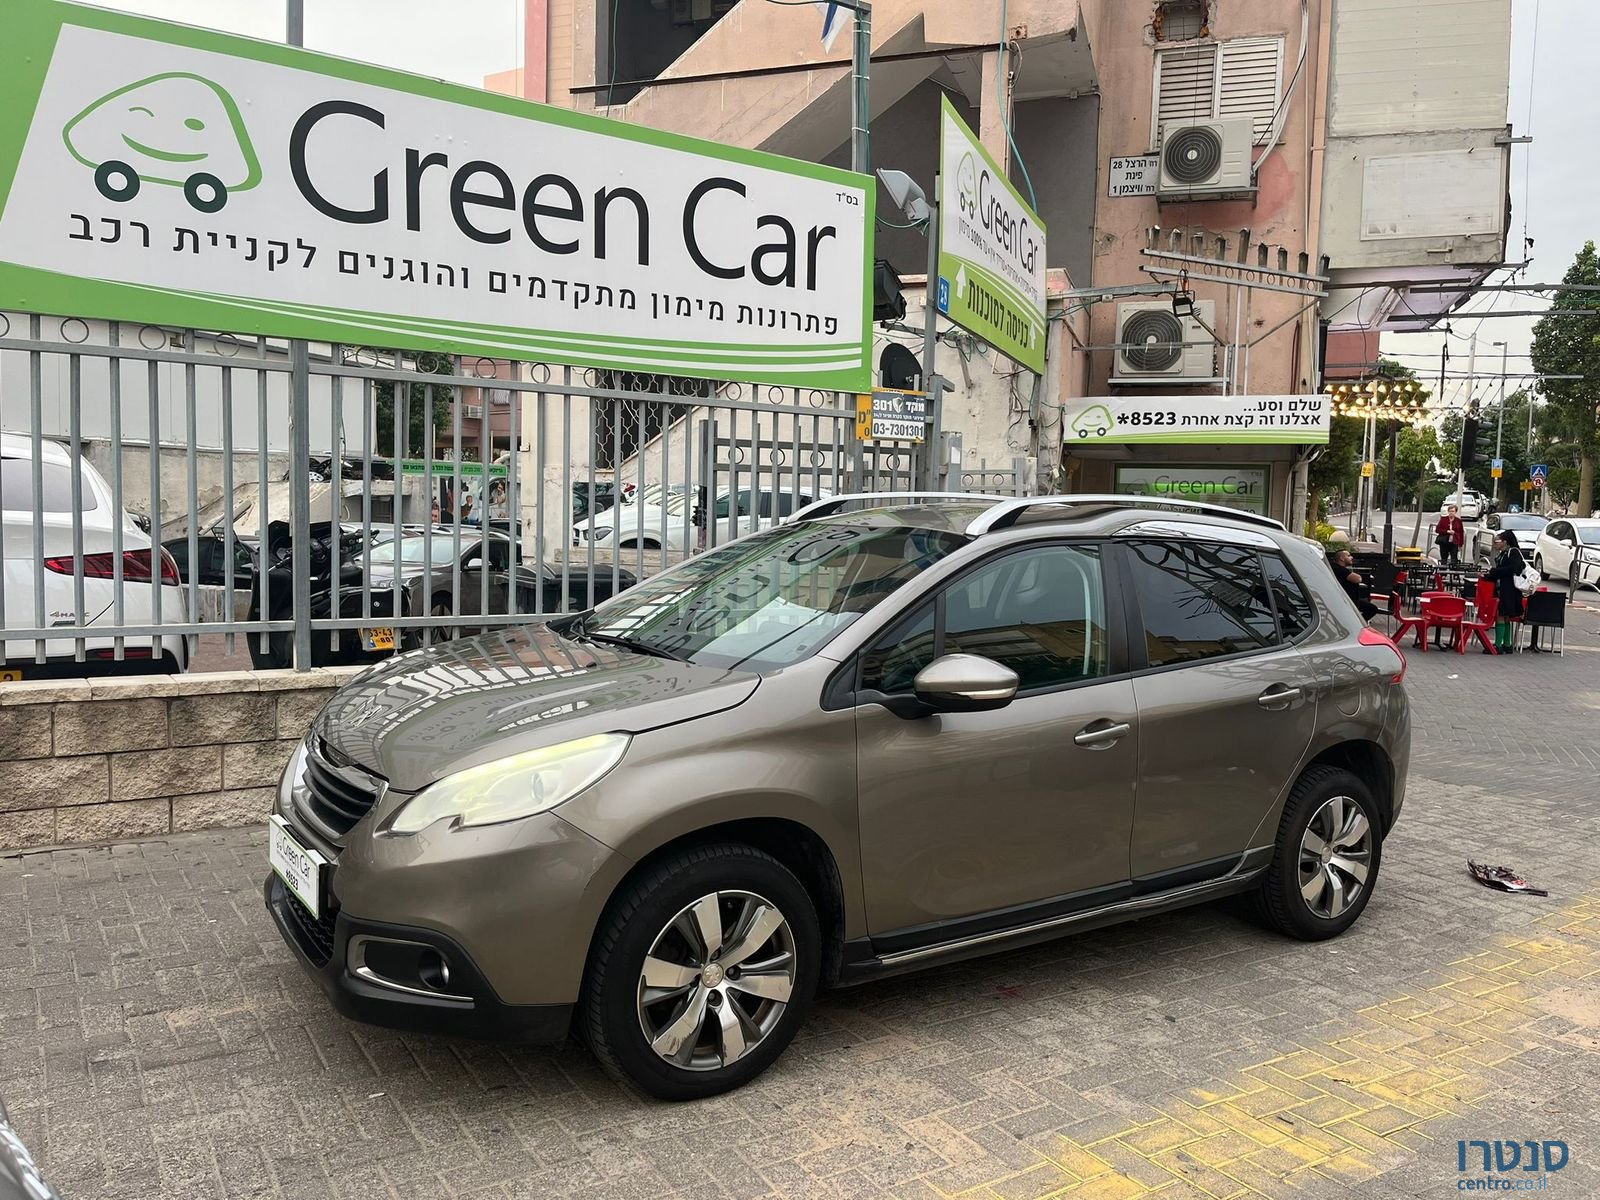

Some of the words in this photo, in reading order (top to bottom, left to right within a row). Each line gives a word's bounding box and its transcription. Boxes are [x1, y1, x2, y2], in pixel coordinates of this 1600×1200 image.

[1112, 160, 1123, 169] 28
[1124, 158, 1147, 168] הרצל
[1125, 171, 1143, 180] פינת
[288, 99, 650, 266] Green
[682, 176, 836, 291] Car
[1112, 185, 1117, 193] 1
[835, 192, 859, 205] בס"ד
[69, 213, 150, 248] רכב
[979, 169, 1017, 259] Green
[1019, 217, 1038, 278] Car
[172, 226, 317, 272] לקניית
[338, 250, 469, 289] והוגנים
[488, 270, 636, 310] מתקדמים
[651, 292, 724, 321] מימון
[967, 278, 1005, 331] לסוכנות
[736, 304, 838, 336] פתרונות
[1006, 309, 1029, 349] כניסה
[873, 399, 892, 411] 301
[905, 401, 925, 413] מוקד
[1243, 401, 1283, 411] וסע...
[1288, 399, 1322, 411] שלם
[1181, 415, 1220, 425] אחרת
[1223, 415, 1254, 428] קצת
[1259, 415, 1275, 425] זה
[1280, 412, 1321, 425] אצלנו
[873, 422, 923, 437] 03-7301301
[1154, 475, 1215, 494] Green
[1221, 475, 1258, 495] Car
[282, 836, 299, 869] Green
[300, 854, 310, 878] Car
